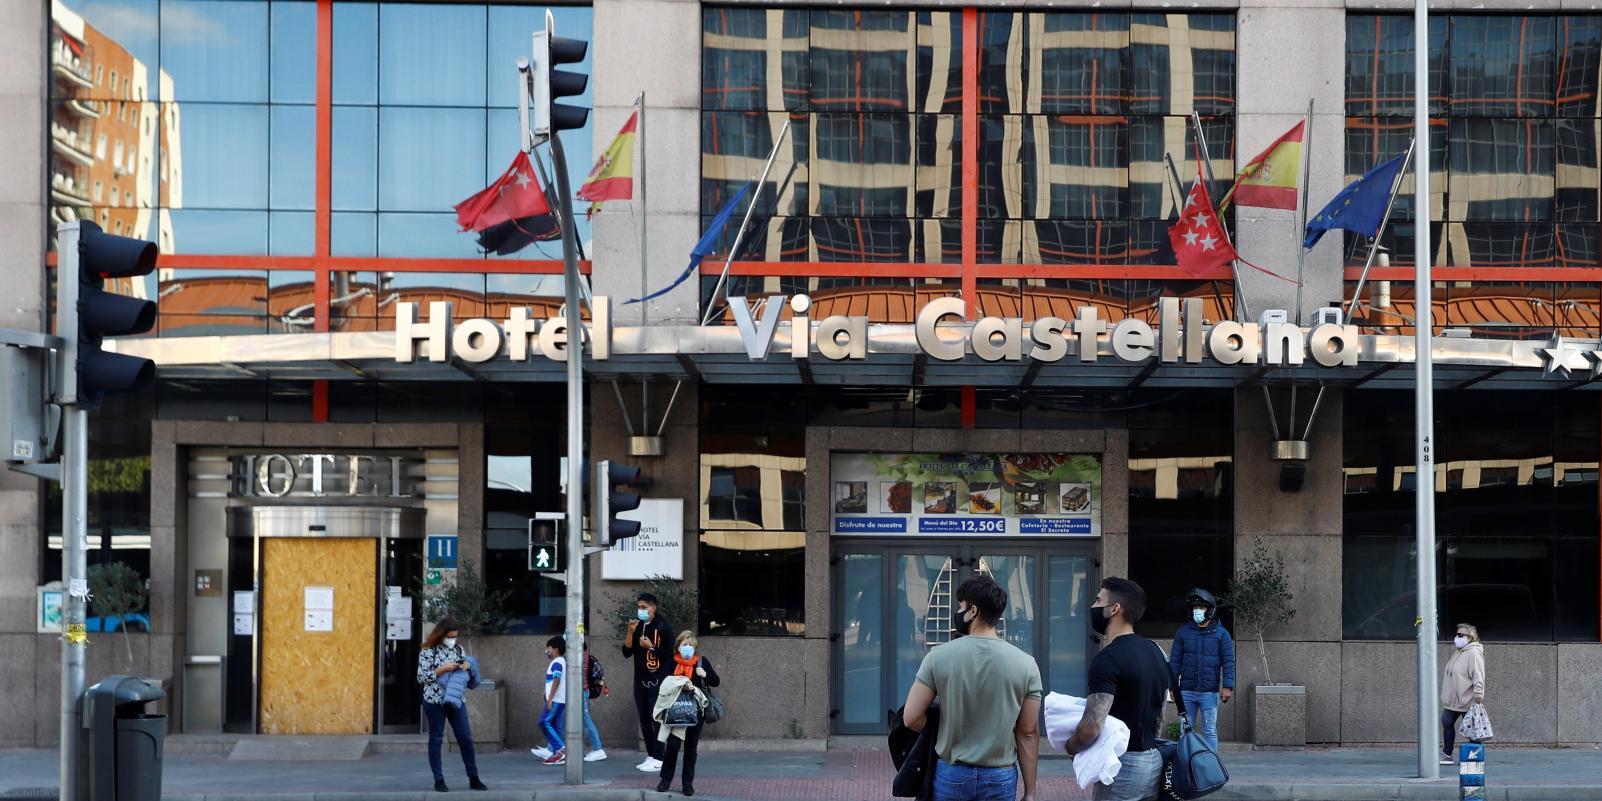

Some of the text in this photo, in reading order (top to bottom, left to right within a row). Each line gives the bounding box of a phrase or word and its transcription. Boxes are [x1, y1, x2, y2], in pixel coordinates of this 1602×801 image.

[395, 293, 1360, 367] Hotel Via Castellana
[227, 454, 414, 497] HOTEL
[839, 521, 866, 529] Disfrute
[867, 521, 876, 529] de
[960, 520, 1005, 533] 12,50€
